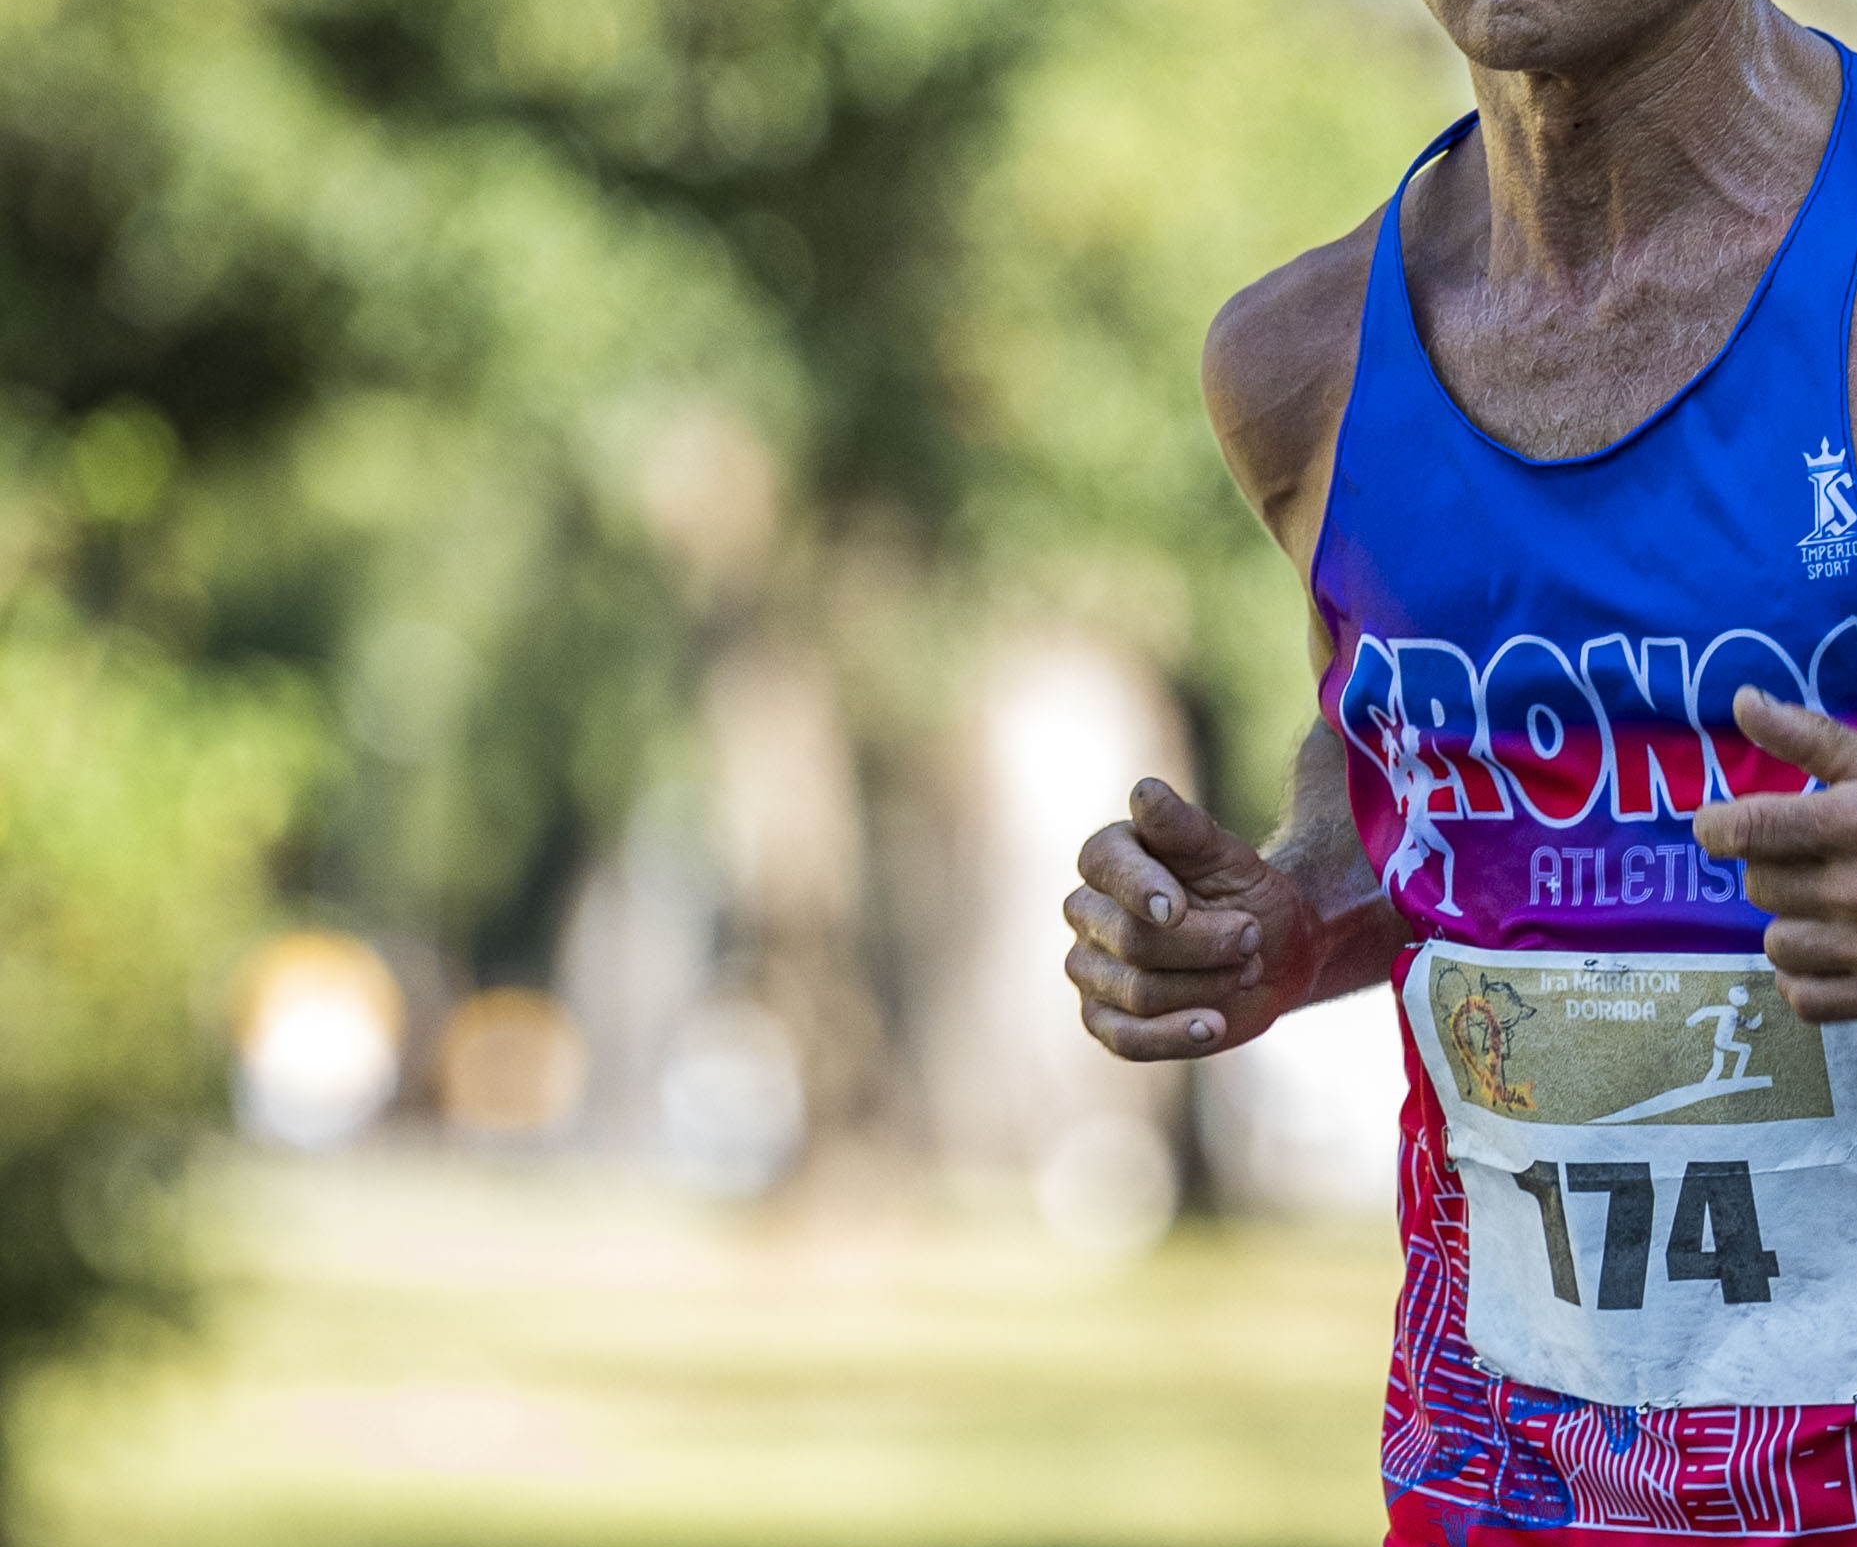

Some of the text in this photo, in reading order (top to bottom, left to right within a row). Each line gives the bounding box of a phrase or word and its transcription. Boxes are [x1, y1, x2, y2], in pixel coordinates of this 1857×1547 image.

[1807, 559, 1850, 580] SPORT
[1528, 843, 1748, 907] ATLETIS
[1565, 998, 1656, 1021] DORADA
[1512, 1159, 1780, 1310] 174
